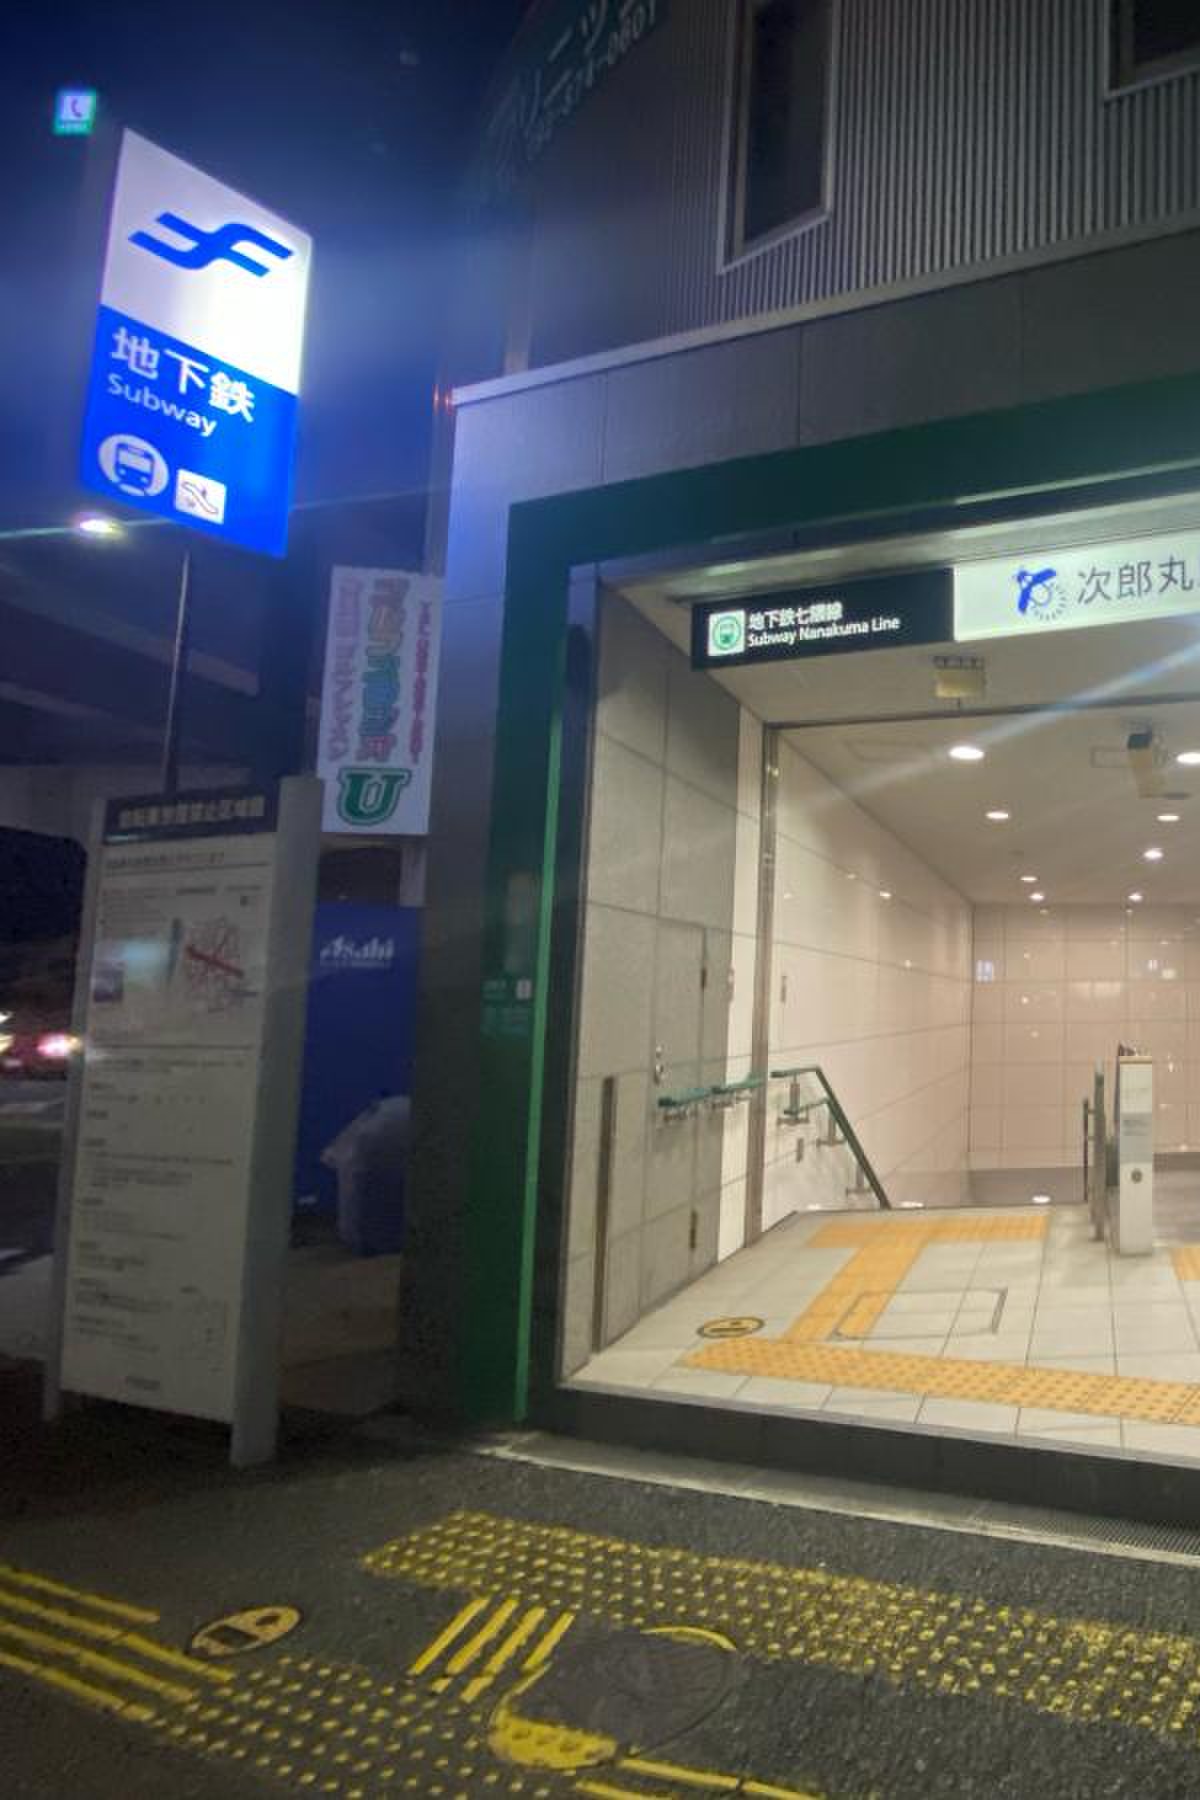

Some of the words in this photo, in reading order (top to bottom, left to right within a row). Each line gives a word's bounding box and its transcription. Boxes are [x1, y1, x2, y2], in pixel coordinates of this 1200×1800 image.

[107, 373, 217, 437] Subway
[110, 326, 255, 423] 地下鉄
[748, 629, 796, 647] Subway
[799, 621, 869, 641] Nanakuma
[871, 616, 900, 632] Line
[336, 767, 412, 826] U
